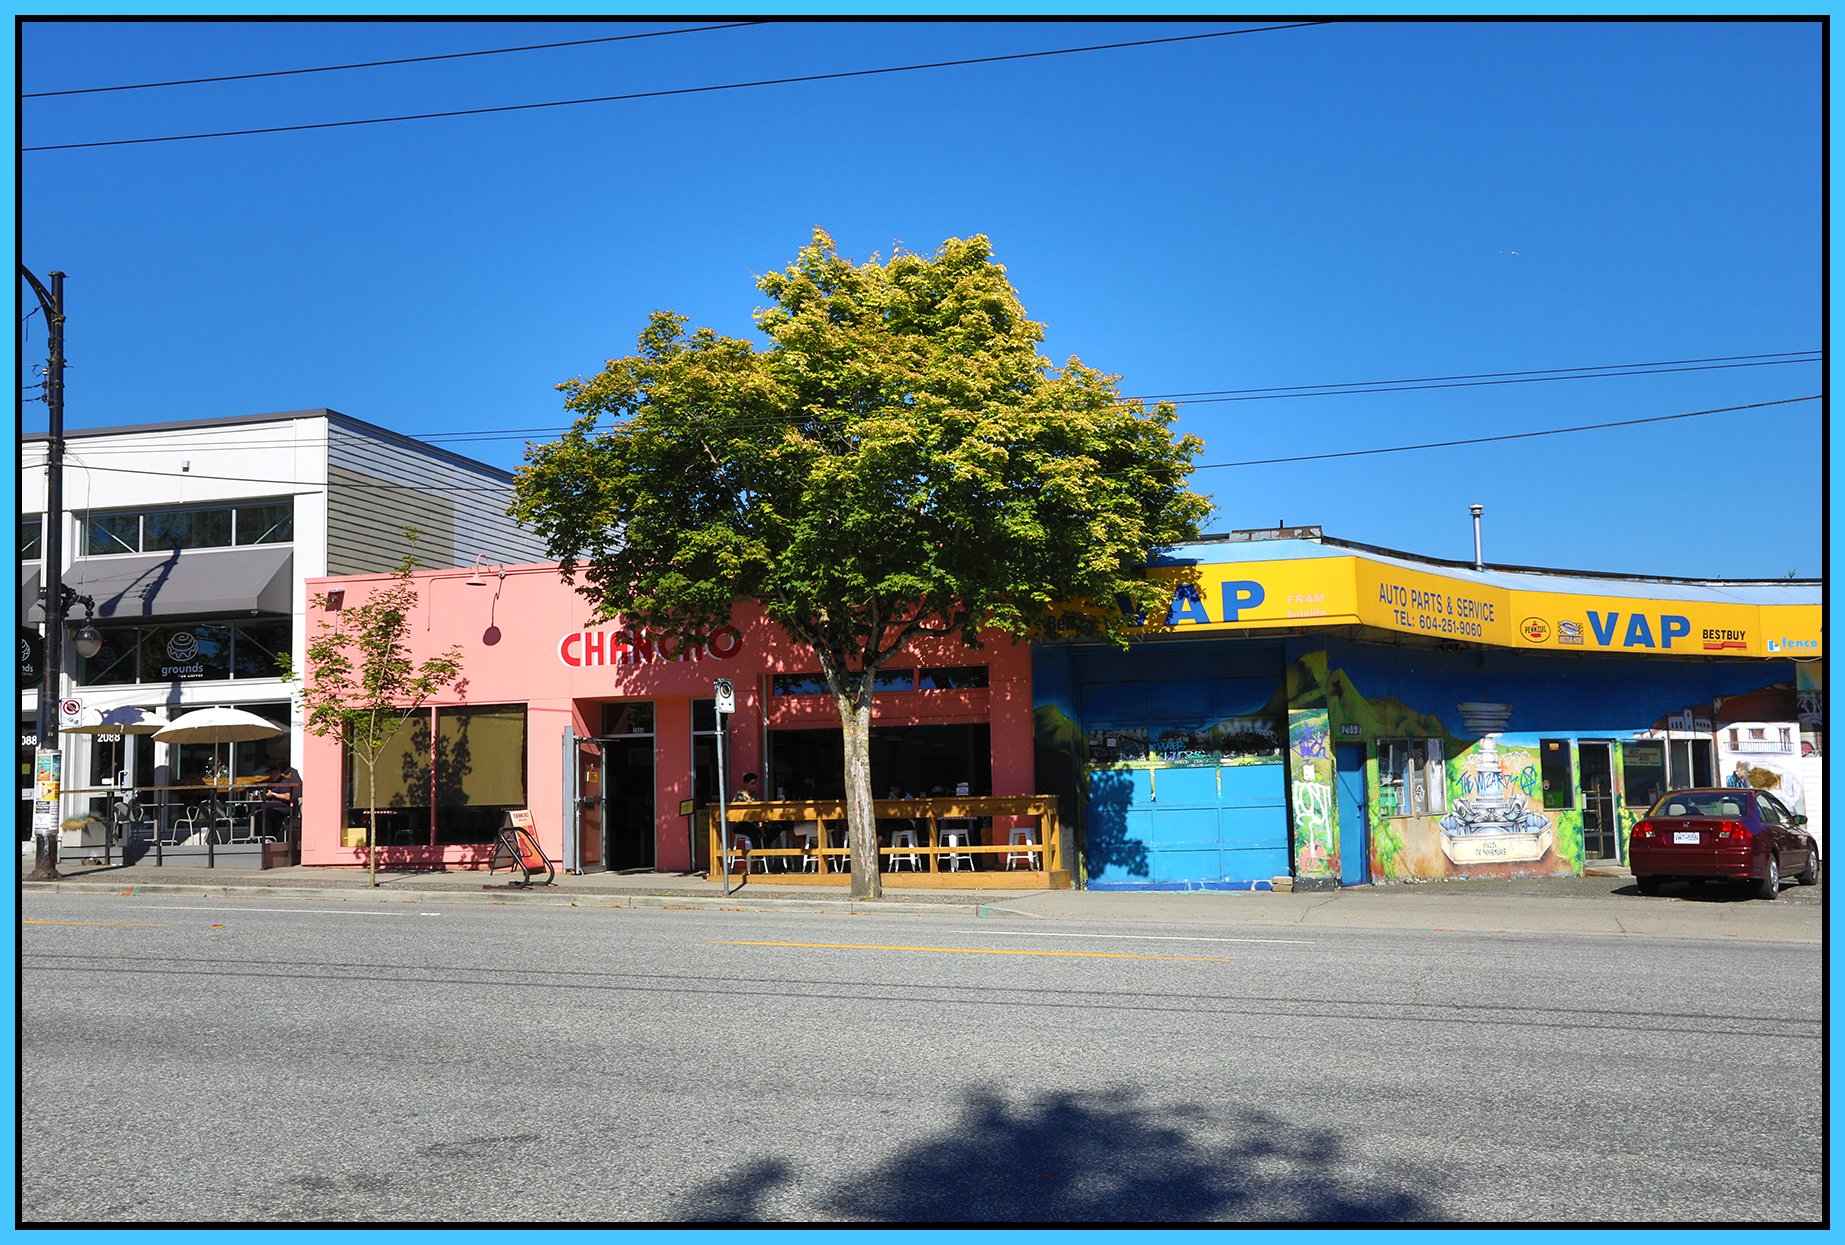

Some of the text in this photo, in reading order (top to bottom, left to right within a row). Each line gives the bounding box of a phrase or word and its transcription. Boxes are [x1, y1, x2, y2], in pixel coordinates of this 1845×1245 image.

[1287, 593, 1325, 605] FRAM
[1380, 583, 1495, 622] AUTO PARTS & SERVICE
[1287, 607, 1327, 620] Autolite
[1393, 609, 1482, 637] TEL: 604-251-9060
[1586, 611, 1691, 648] VAP
[558, 627, 743, 666] CHANCHO
[1781, 637, 1818, 648] fenco
[161, 662, 204, 677] grounds
[97, 733, 121, 742] 2088
